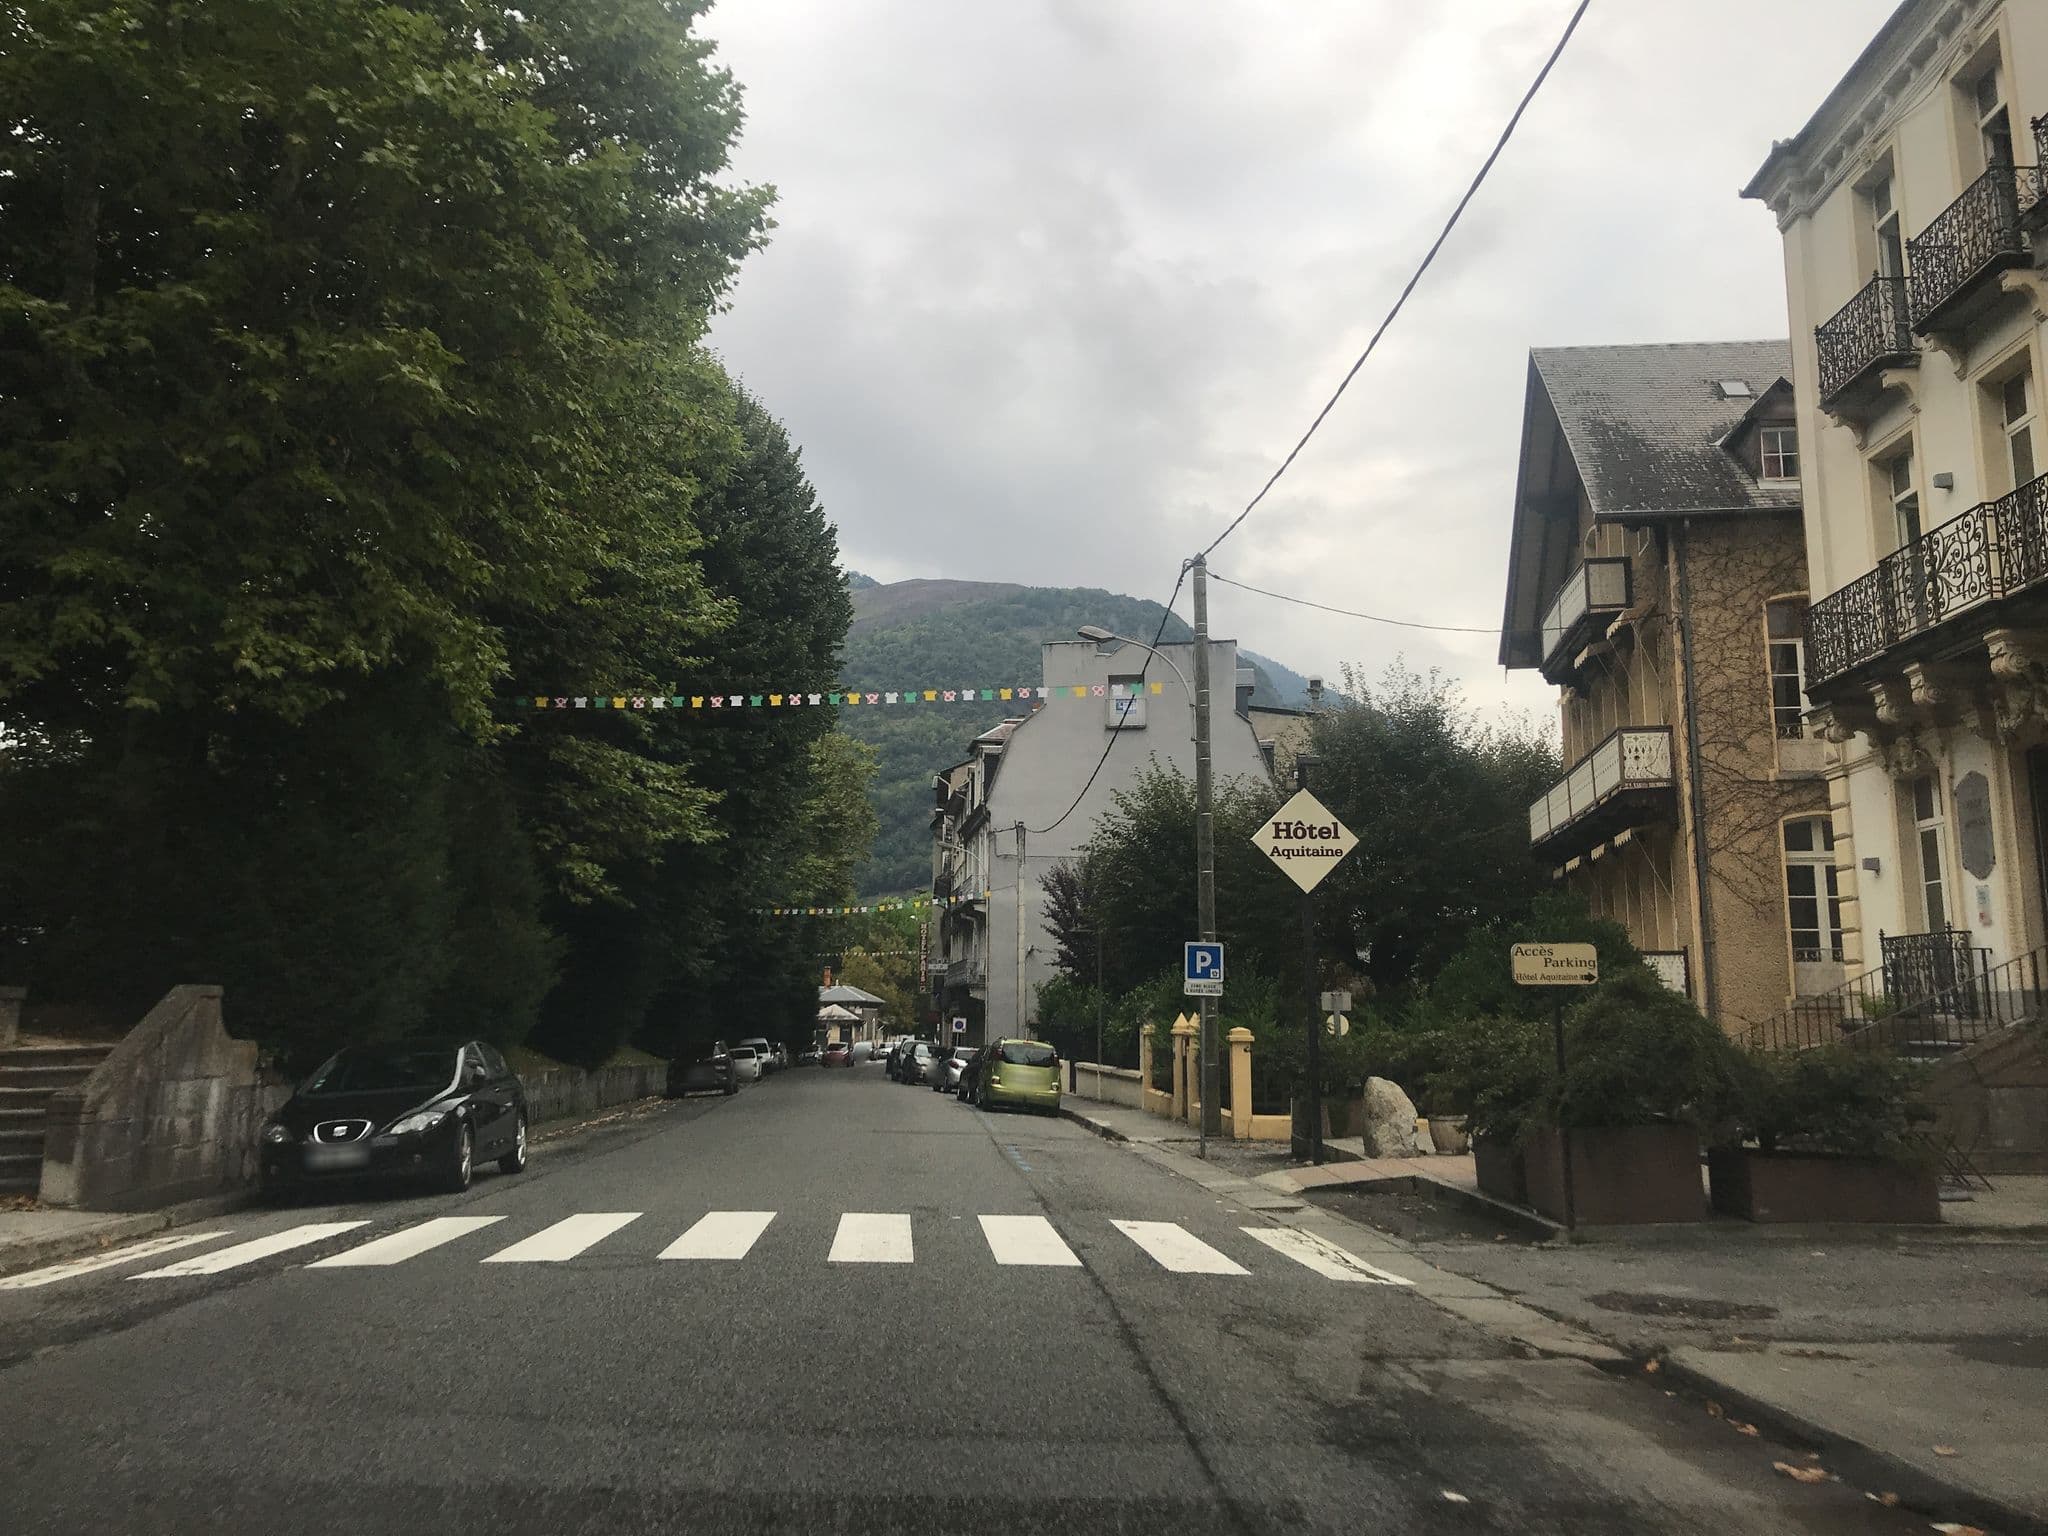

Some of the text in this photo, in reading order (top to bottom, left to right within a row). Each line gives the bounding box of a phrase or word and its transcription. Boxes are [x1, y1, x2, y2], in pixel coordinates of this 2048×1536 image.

[1272, 821, 1340, 840] Hôtel
[1269, 846, 1344, 859] Aquitaine
[1515, 946, 1554, 956] Accès
[1196, 951, 1212, 973] P
[1544, 957, 1597, 970] Parking
